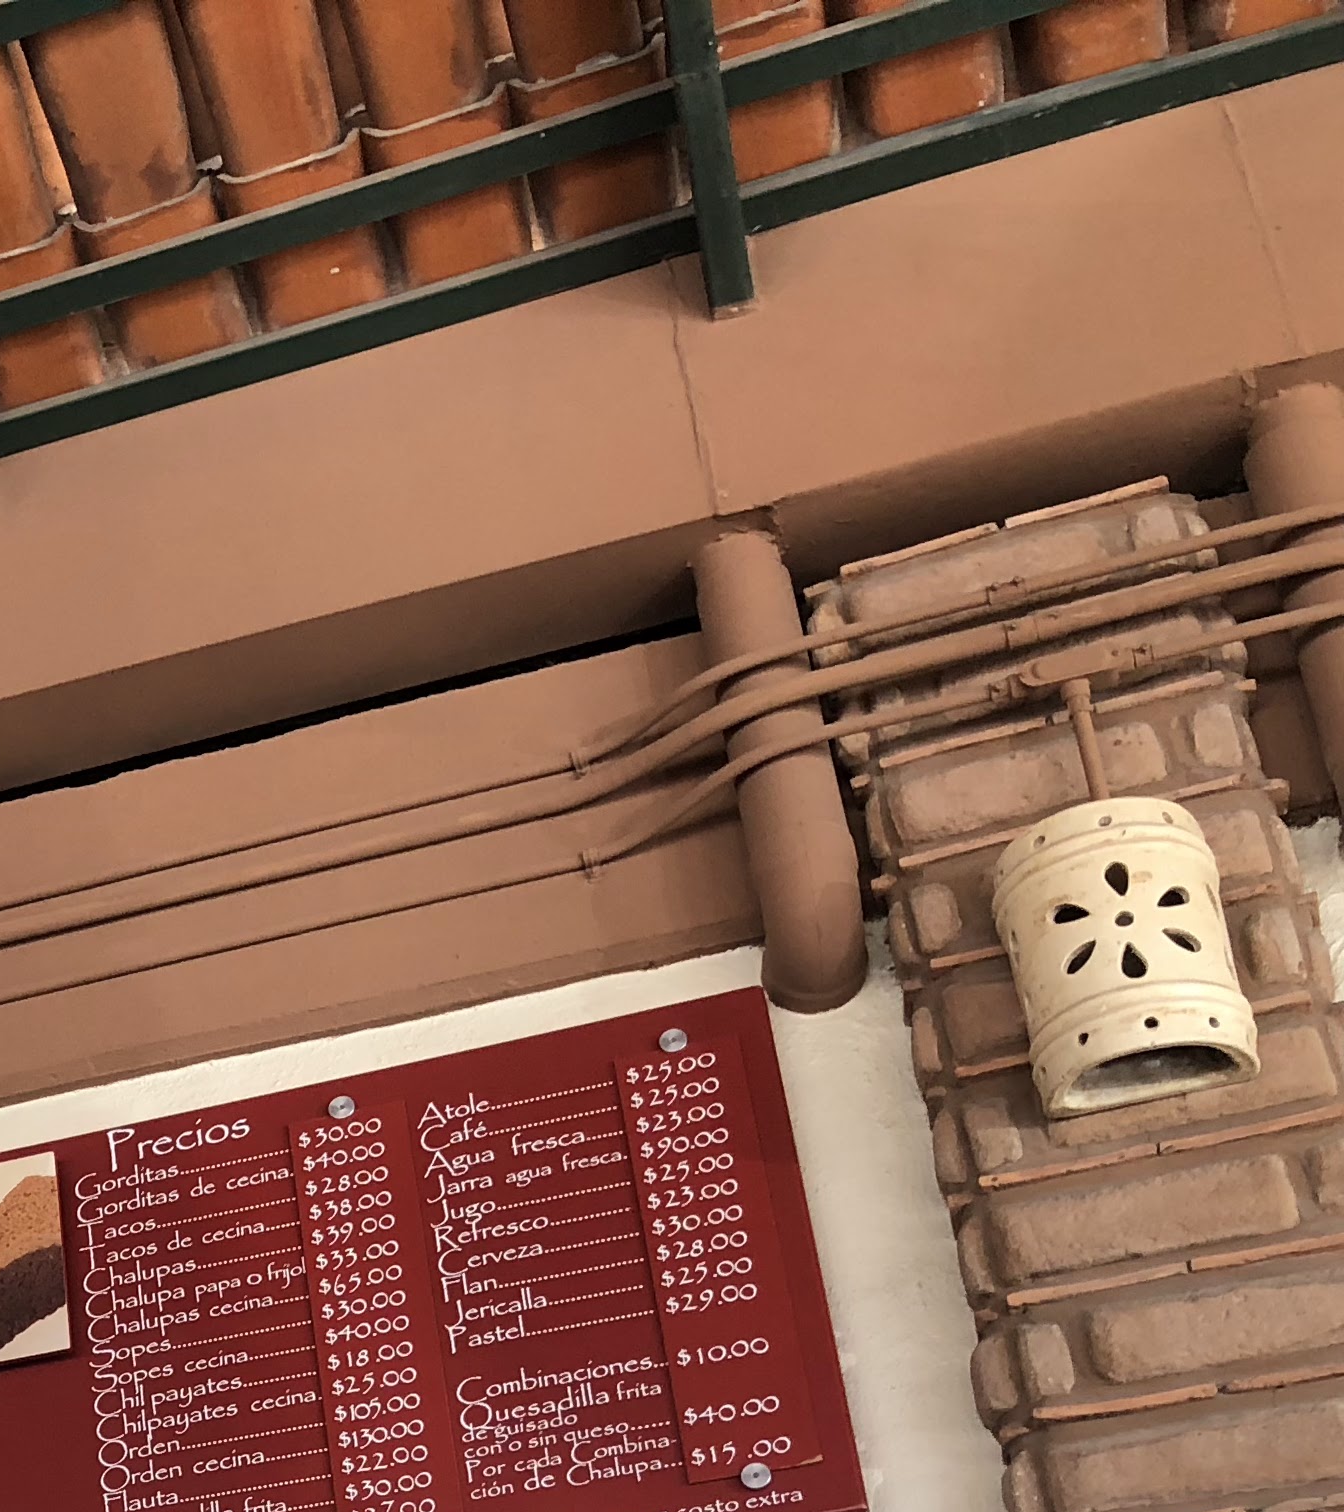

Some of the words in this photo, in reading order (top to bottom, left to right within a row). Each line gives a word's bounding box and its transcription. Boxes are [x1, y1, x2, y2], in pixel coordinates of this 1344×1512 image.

[417, 1093, 490, 1129] Atole
[626, 1053, 716, 1084] $25.00
[420, 1117, 488, 1151] Café
[631, 1077, 719, 1109] $25.00
[75, 1164, 179, 1203] Gorditas
[299, 1118, 381, 1148] $30.00
[107, 1118, 252, 1173] Precios
[424, 1150, 495, 1178] Agua
[511, 1127, 585, 1156] fresca
[637, 1103, 724, 1133] $23.00
[427, 1174, 493, 1203] Jarra
[506, 1166, 551, 1187] agua
[641, 1128, 728, 1159] $90.00
[75, 1183, 181, 1225] Gorditas
[190, 1176, 216, 1197] de
[303, 1142, 385, 1172] $40.00
[77, 1219, 156, 1246] Tacos
[305, 1166, 388, 1196] $28.00
[430, 1199, 496, 1230] Jugo
[644, 1153, 733, 1184] $25.00
[434, 1210, 549, 1255] Refresco
[647, 1179, 738, 1210] $23.00
[79, 1243, 157, 1270] Tacos
[167, 1230, 192, 1250] de
[202, 1222, 264, 1243] cecina
[309, 1191, 392, 1220] $38.00
[83, 1260, 196, 1299] Chalupas
[311, 1214, 395, 1245] $39.00
[437, 1238, 543, 1276] Cerveza
[652, 1205, 743, 1237] $30.00
[441, 1273, 497, 1302] Flan
[657, 1231, 748, 1262] $28.00
[83, 1277, 185, 1322] Chalupa
[195, 1278, 241, 1302] papa
[247, 1274, 262, 1285] o
[267, 1257, 306, 1289] frijol
[316, 1240, 399, 1270] $33.00
[86, 1303, 200, 1343] Chalupas
[210, 1296, 273, 1316] cecina
[319, 1265, 402, 1296] $65.00
[445, 1287, 547, 1329] Jericalla
[661, 1257, 752, 1288] $25.00
[89, 1339, 171, 1367] Sopes
[321, 1290, 406, 1320] $30.00
[90, 1364, 173, 1394] Sopes
[185, 1350, 248, 1372] cecina
[325, 1315, 409, 1345] $40.00
[328, 1341, 413, 1371] $18.00
[444, 1313, 525, 1354] Pastel
[666, 1284, 757, 1314] $29.00
[677, 1338, 769, 1366] $10.00
[96, 1404, 238, 1442] Chilpayates
[332, 1367, 417, 1396] $25.00
[97, 1440, 180, 1467] Orden
[334, 1393, 420, 1422] $105.00
[456, 1378, 609, 1434] Quesadilla
[617, 1381, 661, 1400] frita
[461, 1425, 487, 1440] de
[494, 1409, 577, 1443] guisado
[464, 1444, 502, 1458] con
[508, 1441, 521, 1451] o
[529, 1431, 557, 1448] sin
[569, 1423, 628, 1442] queso
[684, 1396, 779, 1425] $40.00
[99, 1459, 182, 1492] Orden
[193, 1452, 264, 1473] cecina
[338, 1419, 424, 1449] $130.00
[341, 1445, 428, 1474] $22.00
[345, 1472, 432, 1501] $30.00
[465, 1460, 506, 1486] Por
[515, 1447, 562, 1474] cada
[570, 1434, 676, 1467] Combina-
[471, 1481, 514, 1499] ción
[524, 1460, 555, 1487] de
[746, 1491, 803, 1508] extra
